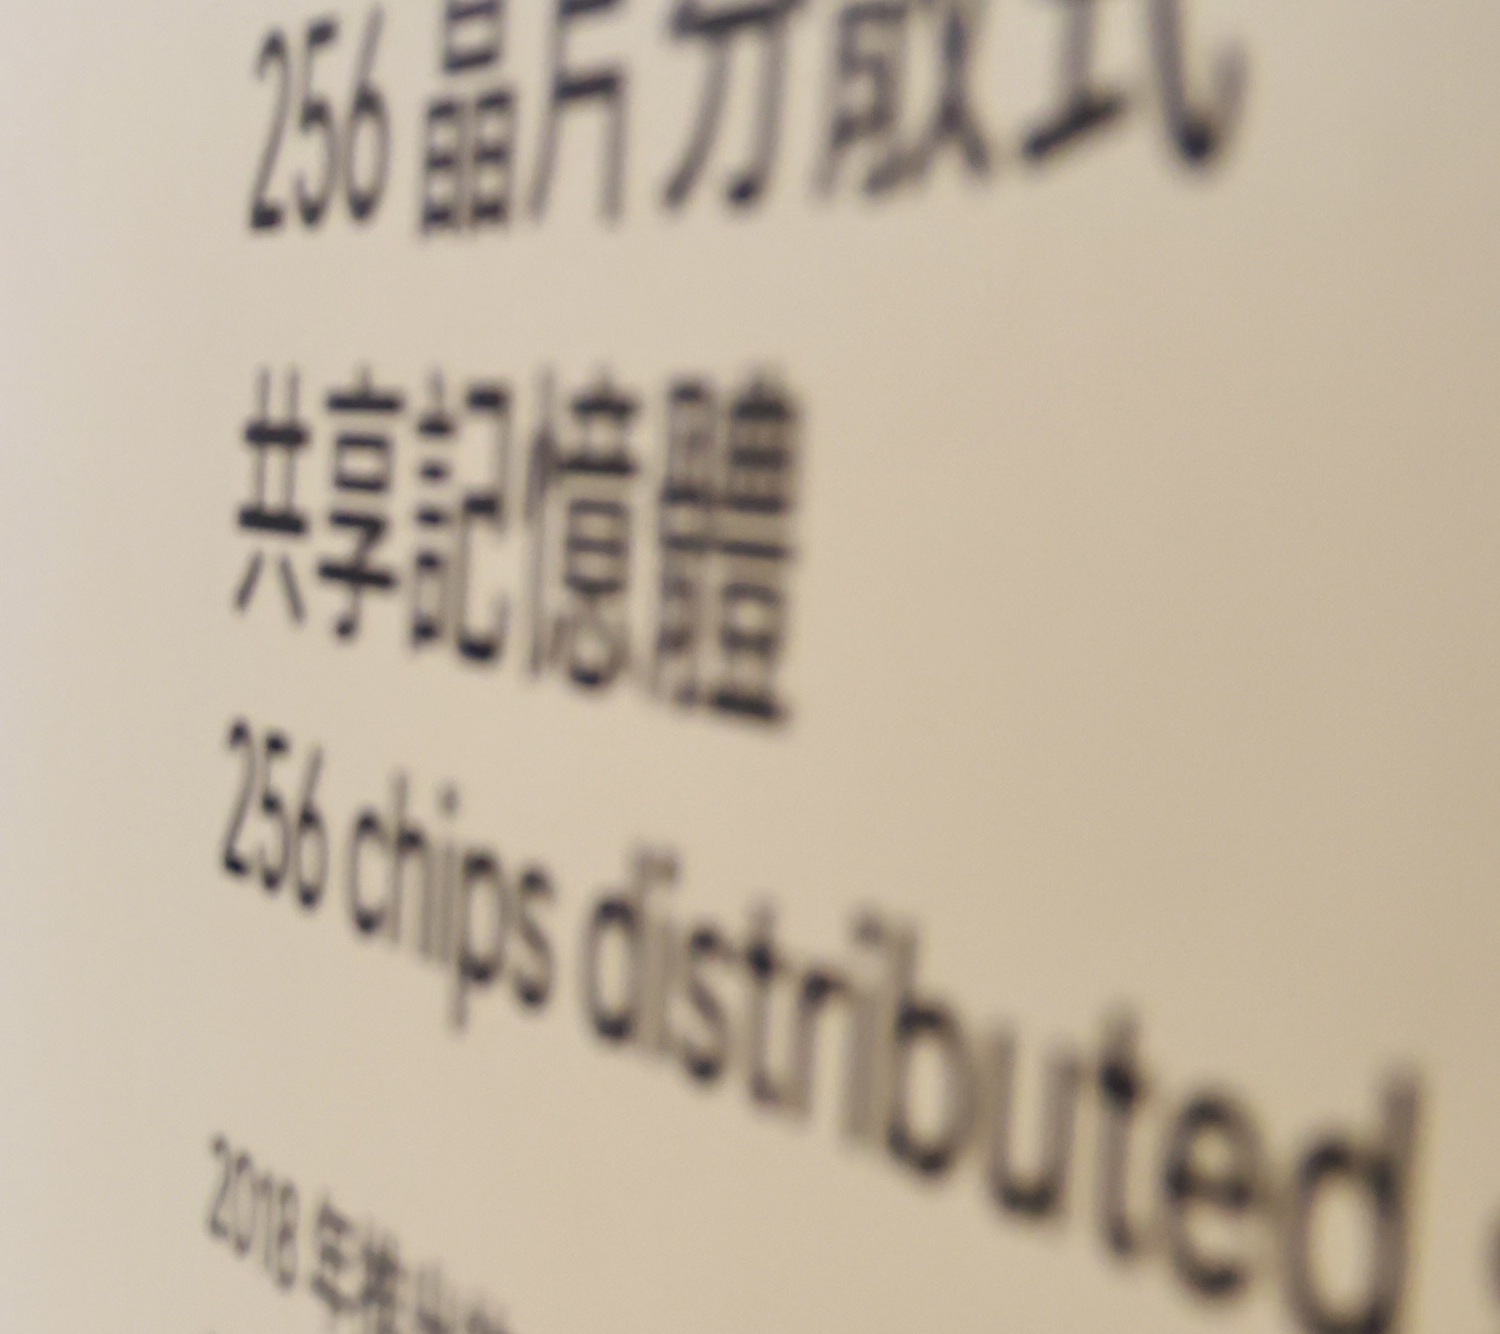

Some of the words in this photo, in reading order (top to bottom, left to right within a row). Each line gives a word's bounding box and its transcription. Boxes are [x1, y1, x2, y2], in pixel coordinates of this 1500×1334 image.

[250, 2, 396, 234] 256
[235, 364, 808, 735] 共享記憶體
[218, 714, 332, 911] 256
[345, 764, 556, 1035] chips
[207, 1131, 300, 1292] 2018
